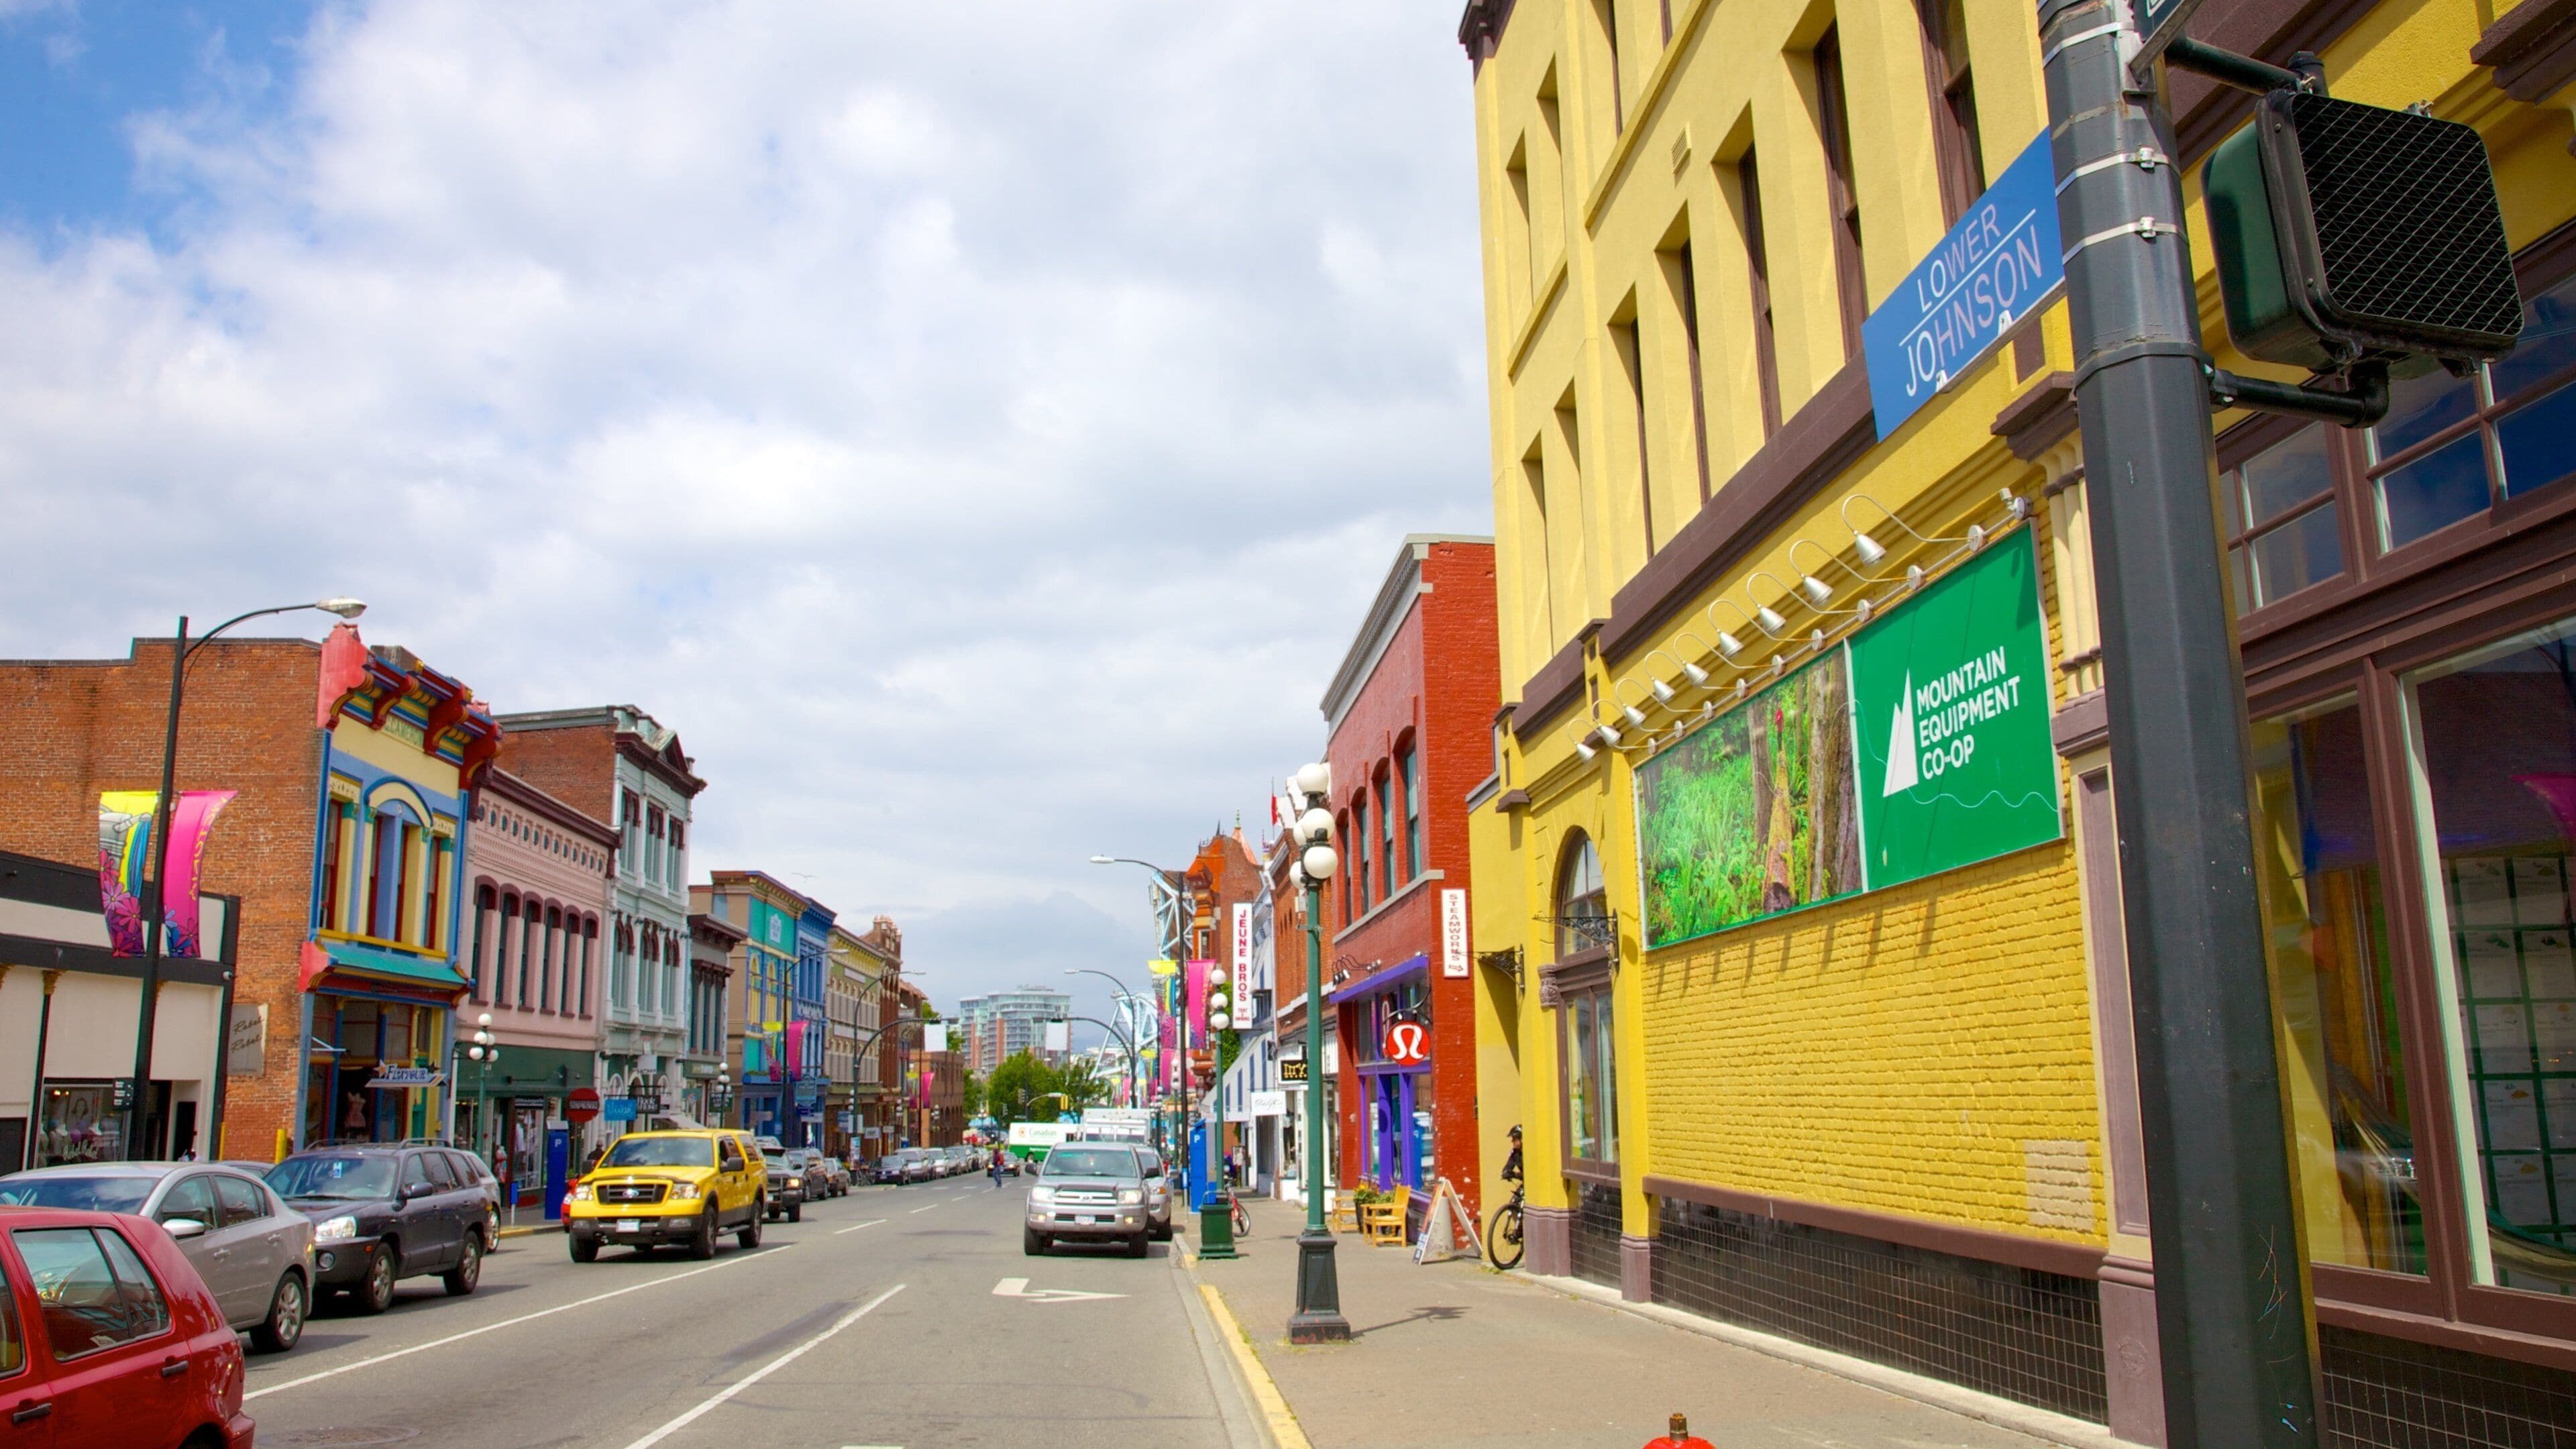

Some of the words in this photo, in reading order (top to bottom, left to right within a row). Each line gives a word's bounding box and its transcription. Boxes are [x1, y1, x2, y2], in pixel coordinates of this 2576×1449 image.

[1917, 203, 2001, 314] LOWER
[1906, 225, 2043, 397] JOHNSON
[1917, 645, 2006, 716] MOUNTAIN
[1919, 675, 2021, 748] EQUIPMENT
[1922, 734, 1975, 780] CO-OP
[1238, 909, 1246, 957] JEUNE
[1449, 894, 1461, 961] STEAMWORKS
[1238, 963, 1247, 1002] BROS
[555, 1139, 561, 1147] P
[1194, 1134, 1201, 1143] P
